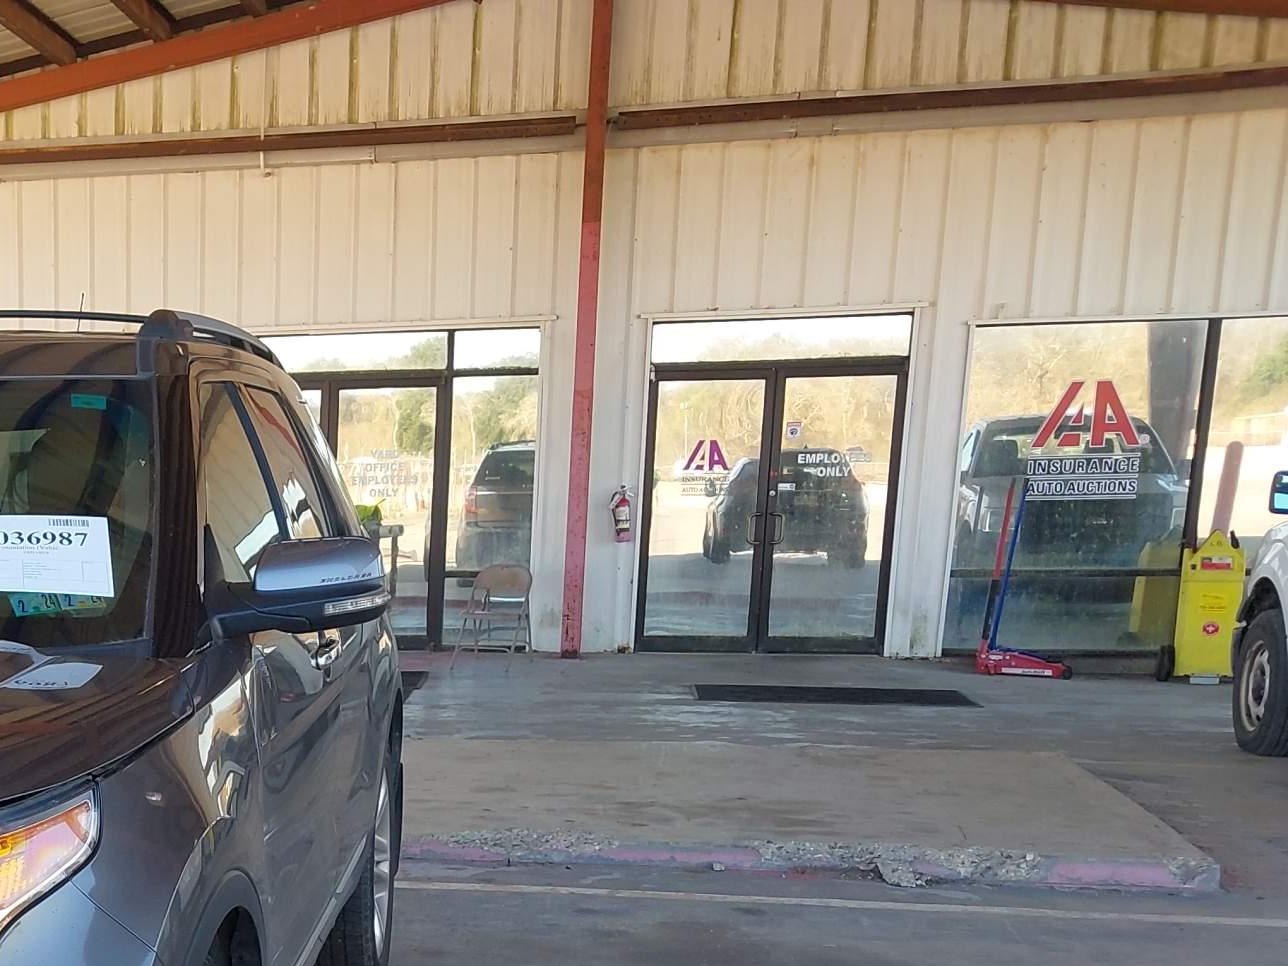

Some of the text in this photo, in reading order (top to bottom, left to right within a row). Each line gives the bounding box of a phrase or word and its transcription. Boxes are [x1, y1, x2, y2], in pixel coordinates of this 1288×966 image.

[365, 463, 406, 473] OFFICE
[817, 466, 851, 477] ONLY
[1027, 458, 1140, 475] INSURANCE
[1025, 479, 1138, 495] AUTO AUCTIONS
[369, 488, 399, 498] ONLY
